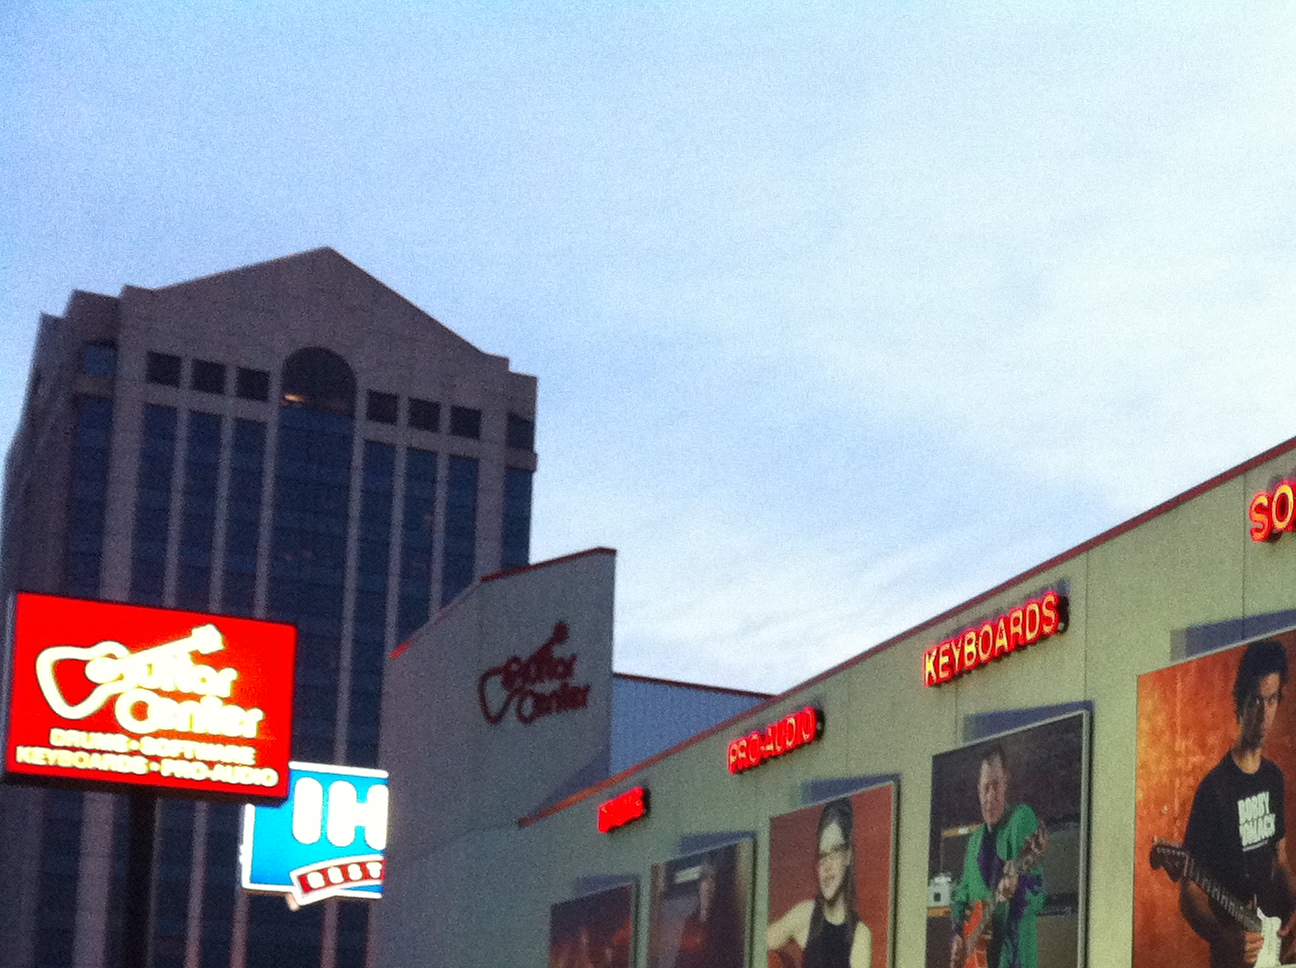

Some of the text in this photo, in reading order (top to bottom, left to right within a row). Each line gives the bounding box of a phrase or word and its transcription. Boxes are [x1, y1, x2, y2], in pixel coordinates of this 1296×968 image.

[36, 623, 239, 720] Guitar
[922, 590, 1060, 687] KEYBOARDS
[115, 688, 264, 738] Center
[727, 706, 818, 775] PRO-AUDIO
[16, 746, 149, 775] KEYBOARDS
